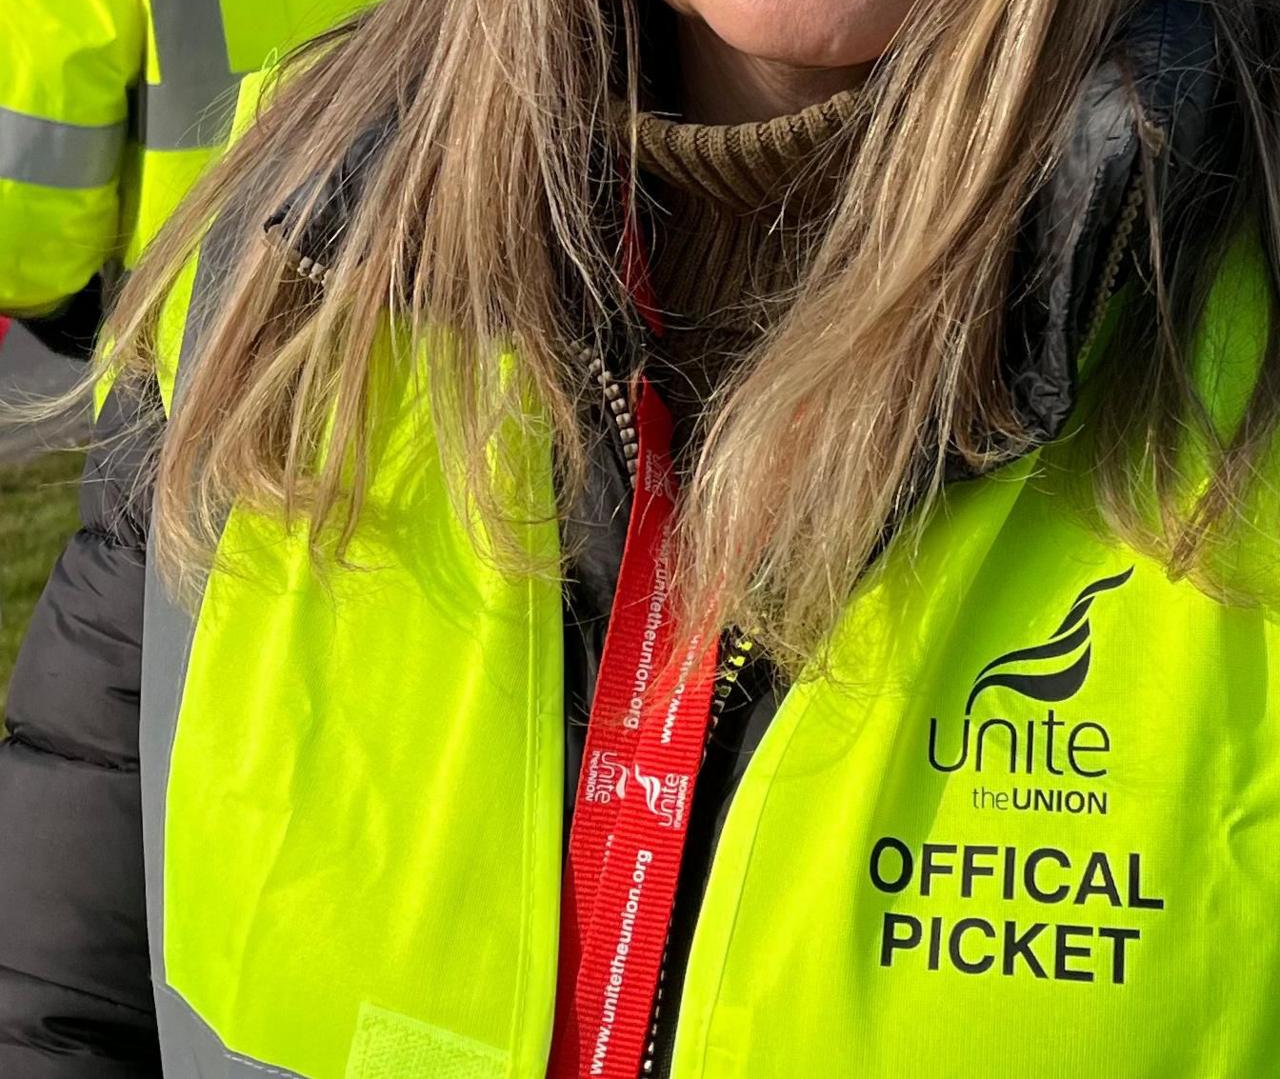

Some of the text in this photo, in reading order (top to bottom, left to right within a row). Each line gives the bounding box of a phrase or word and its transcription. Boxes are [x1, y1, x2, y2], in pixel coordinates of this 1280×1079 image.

[868, 836, 1164, 910] OFFICAL
[589, 849, 653, 1076] www.unitetheunion.org
[879, 911, 1141, 985] PICKET
